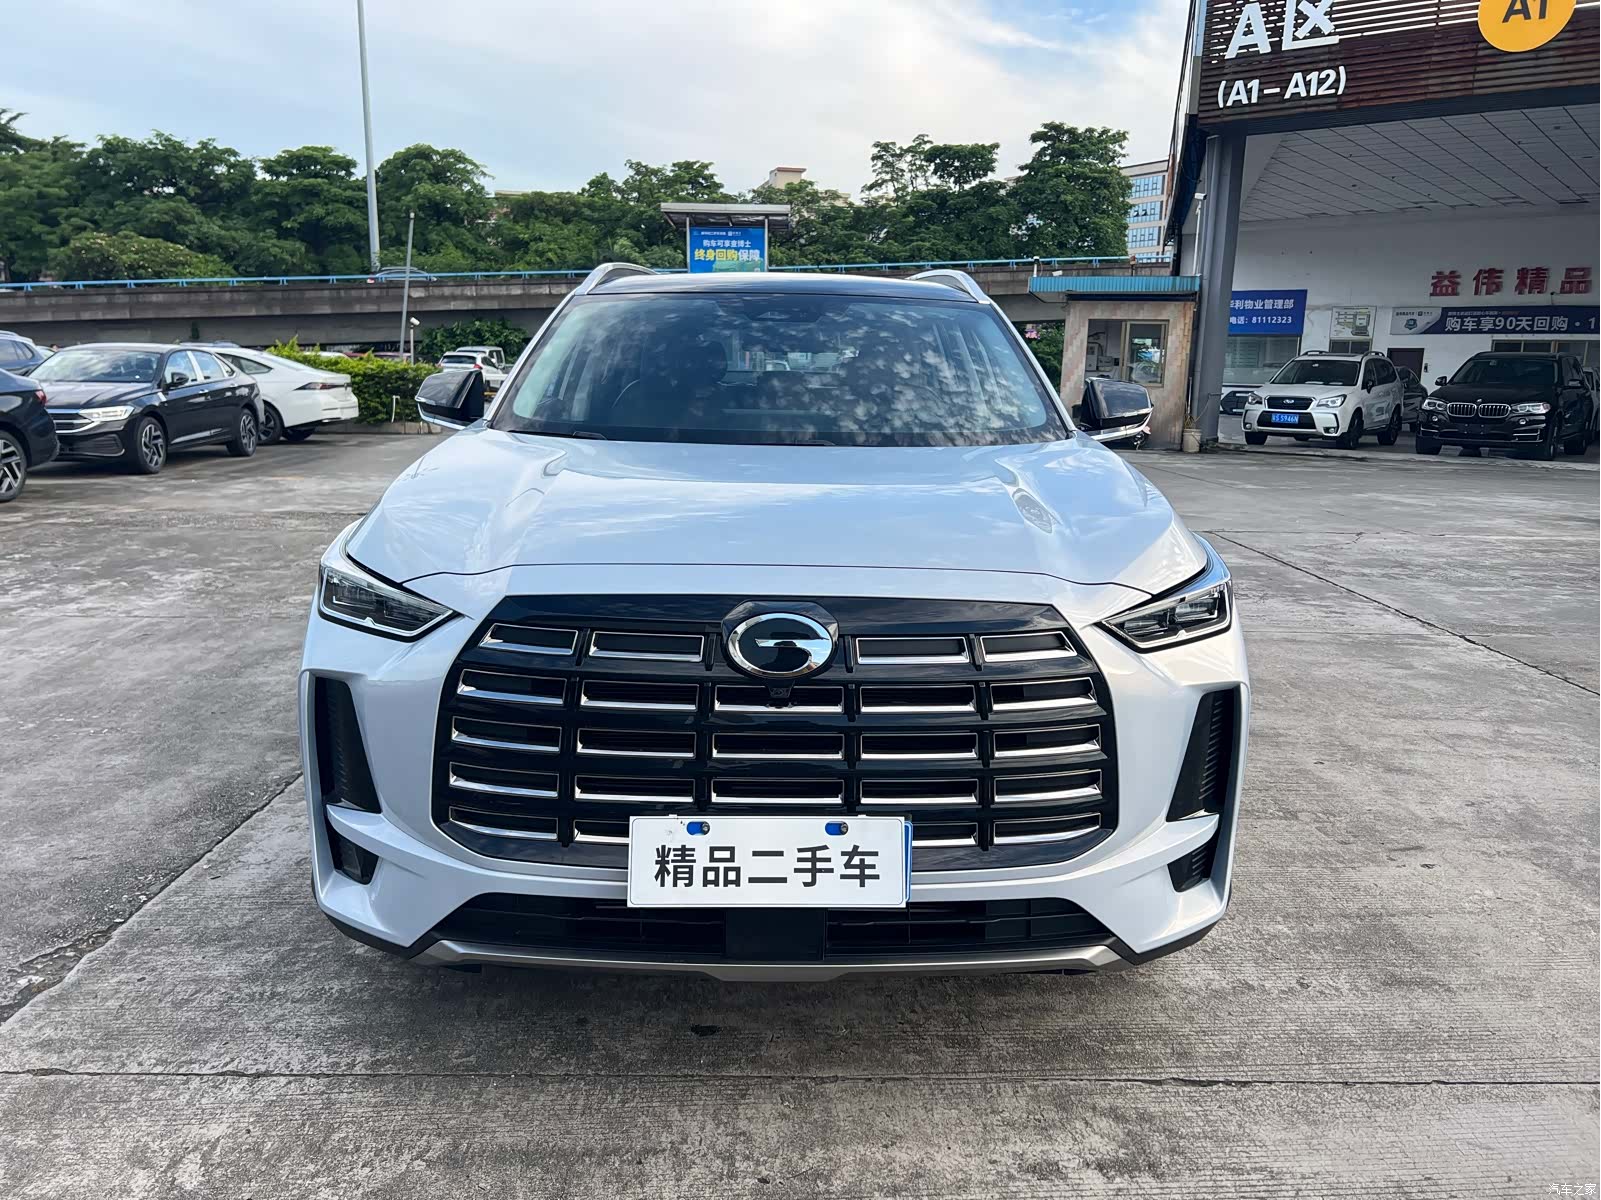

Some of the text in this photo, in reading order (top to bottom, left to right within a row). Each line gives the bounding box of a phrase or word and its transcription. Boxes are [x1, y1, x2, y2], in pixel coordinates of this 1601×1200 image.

[694, 248, 760, 261] 终身回购保障
[1429, 266, 1593, 297] 益伟精品
[654, 844, 880, 888] 精品二手车
